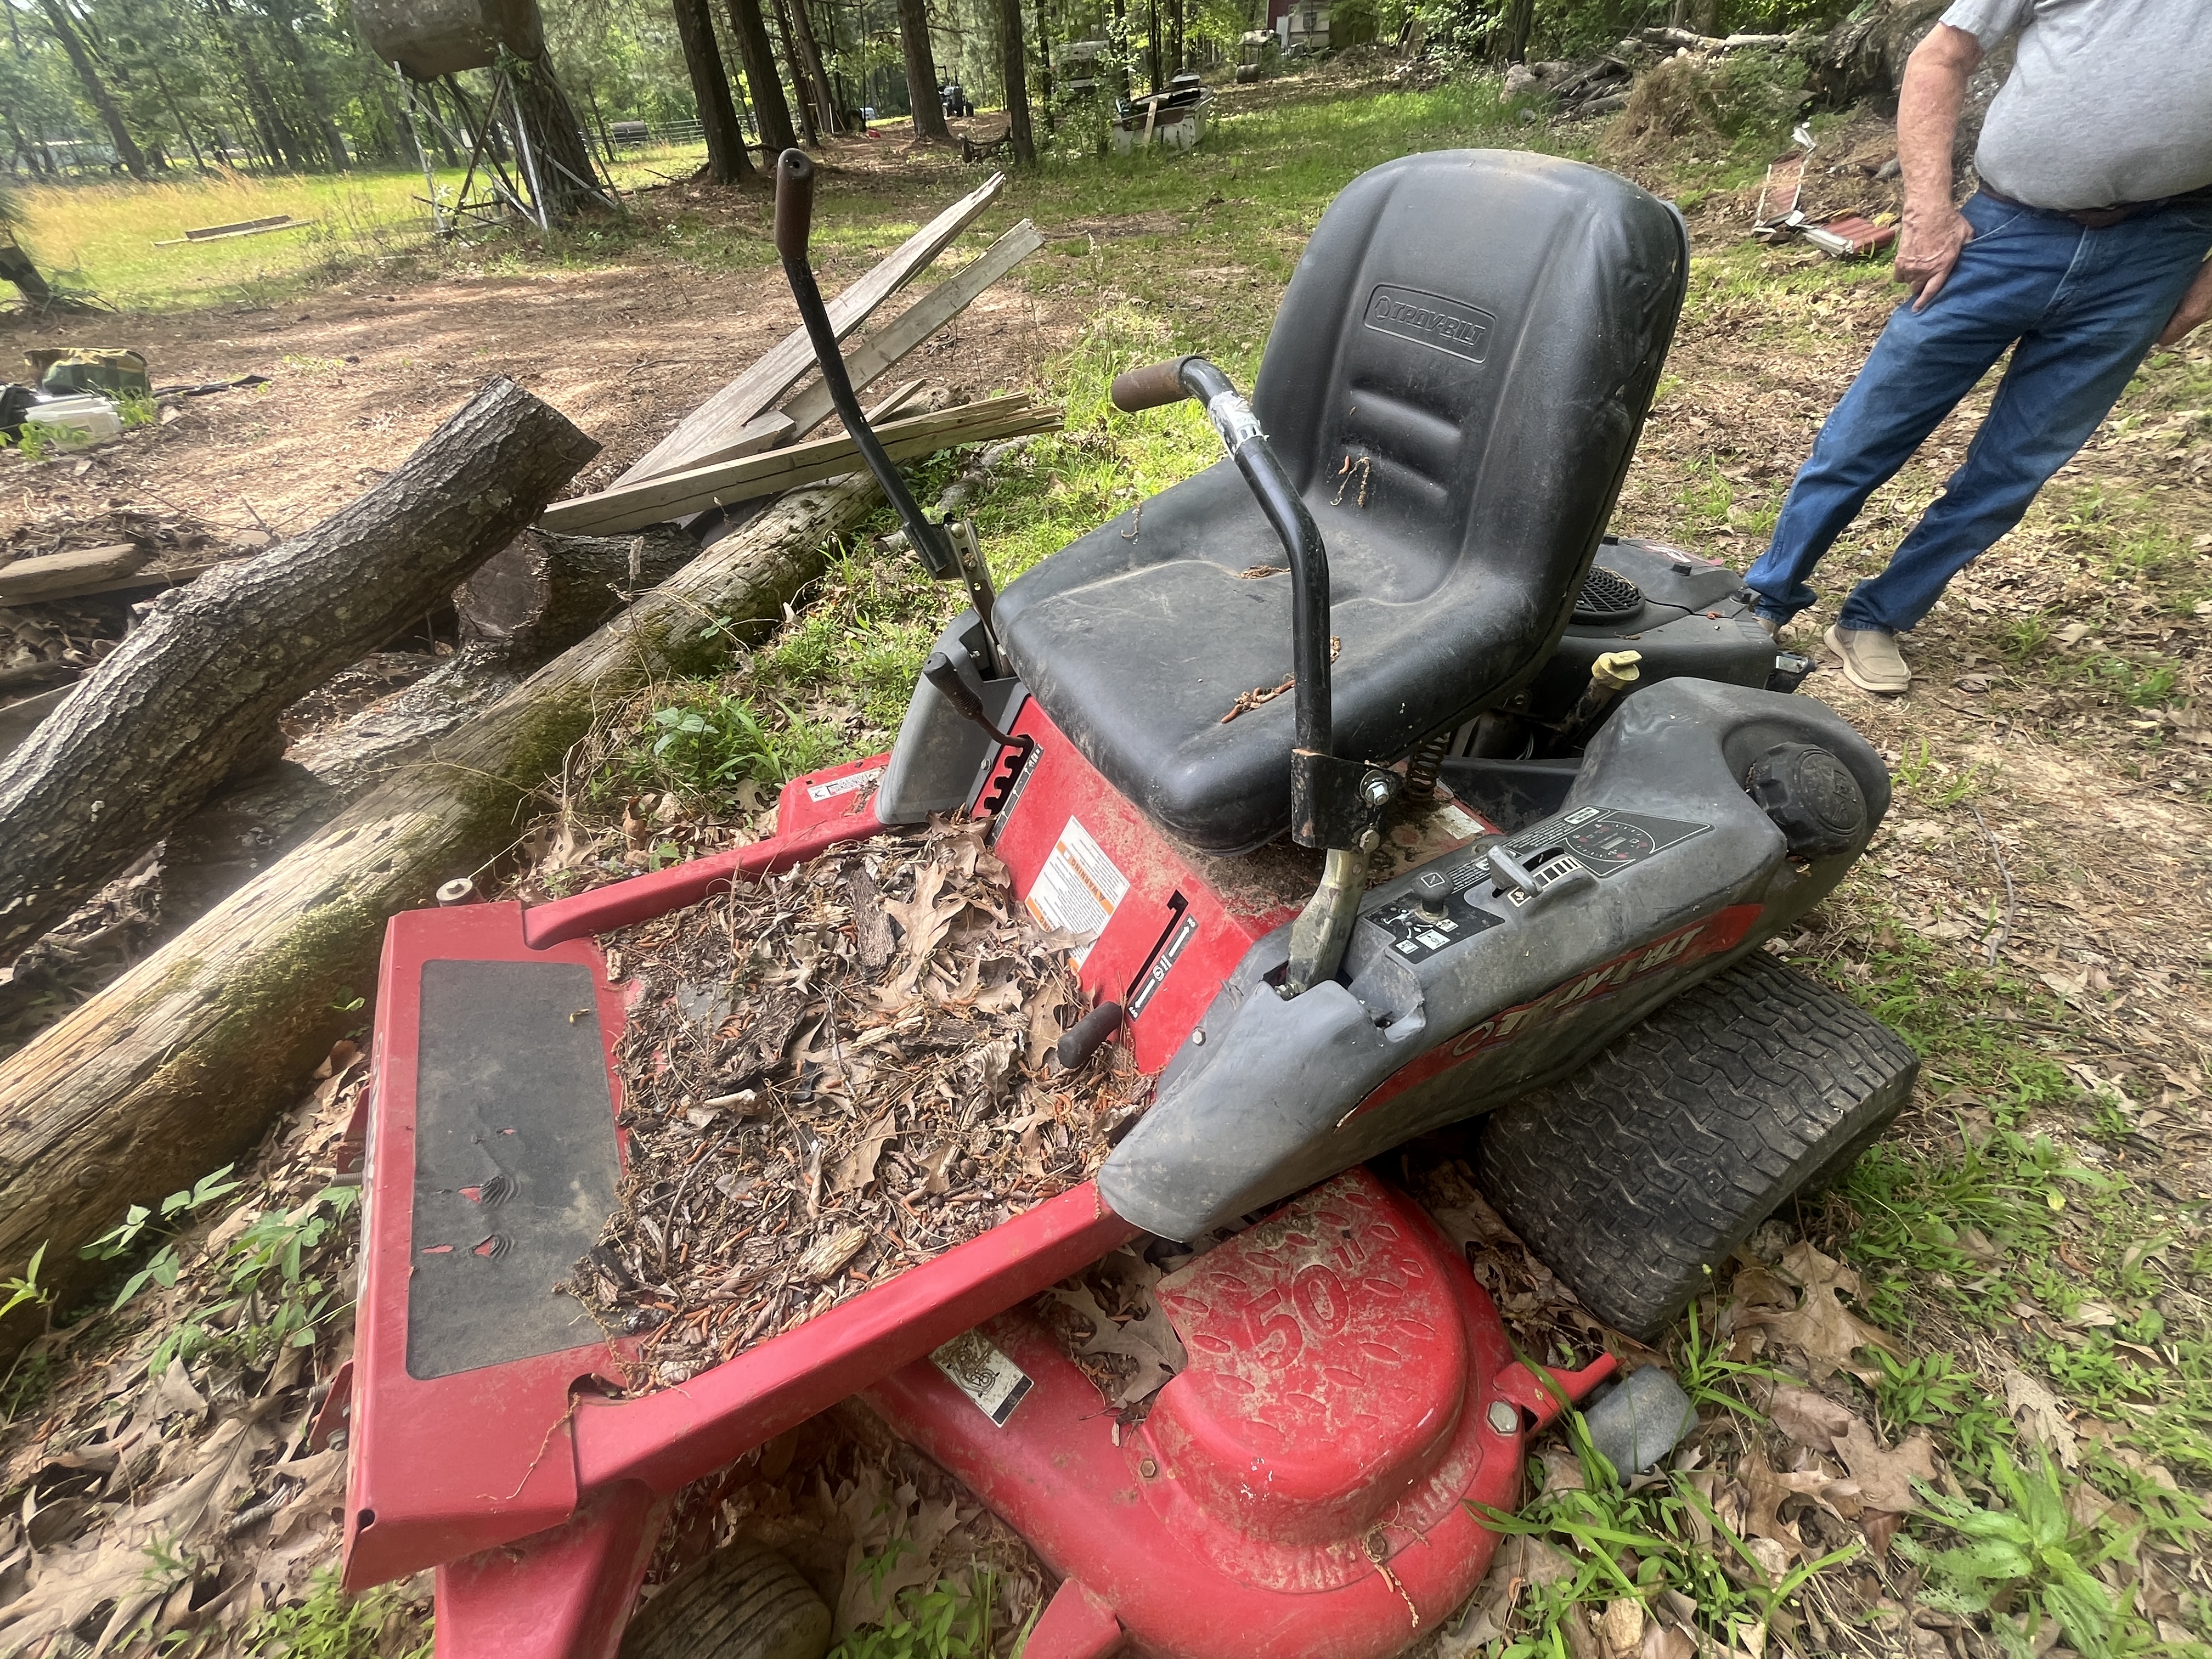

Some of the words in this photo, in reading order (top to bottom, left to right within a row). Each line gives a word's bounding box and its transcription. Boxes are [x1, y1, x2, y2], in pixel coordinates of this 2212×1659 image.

[1070, 856, 1098, 896] WARNING
[1187, 917, 1196, 928] ON
[1128, 1006, 1138, 1018] OFF
